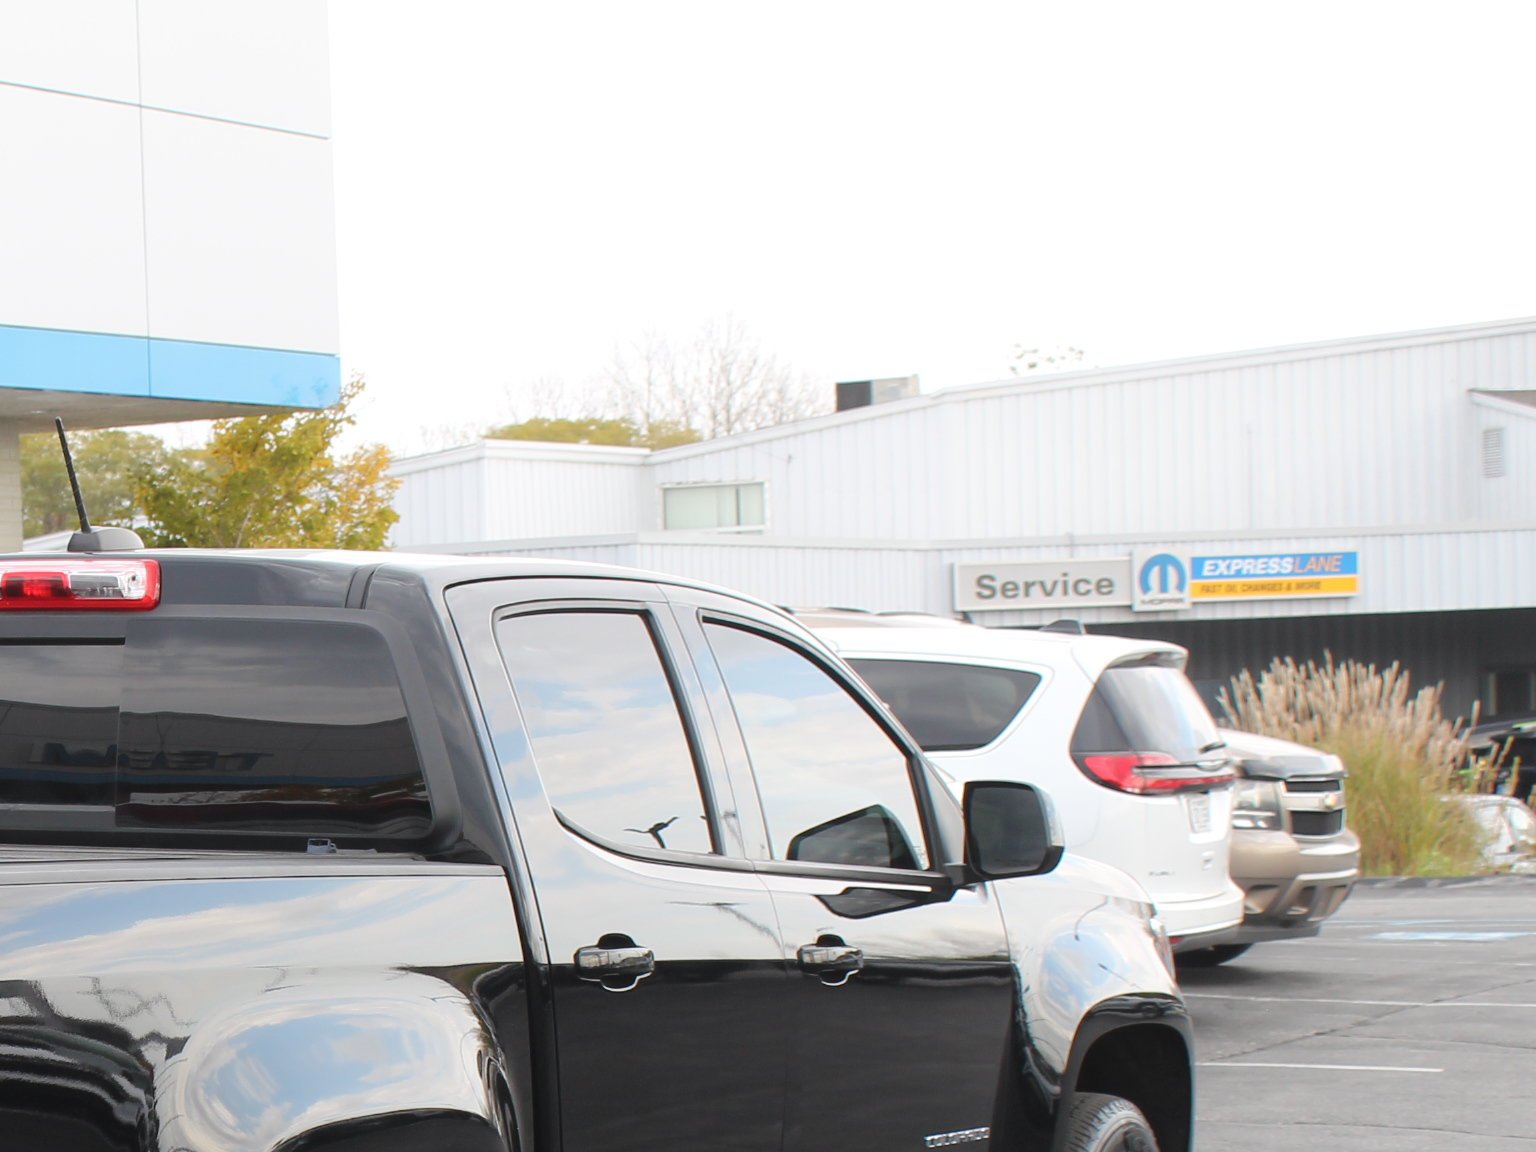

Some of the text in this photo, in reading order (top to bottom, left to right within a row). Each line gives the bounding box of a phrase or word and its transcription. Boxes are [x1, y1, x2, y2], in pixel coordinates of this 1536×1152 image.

[975, 573, 1115, 599] Service
[1200, 584, 1222, 594] FAST
[1242, 581, 1283, 593] CHANGES
[1296, 580, 1322, 591] MORE
